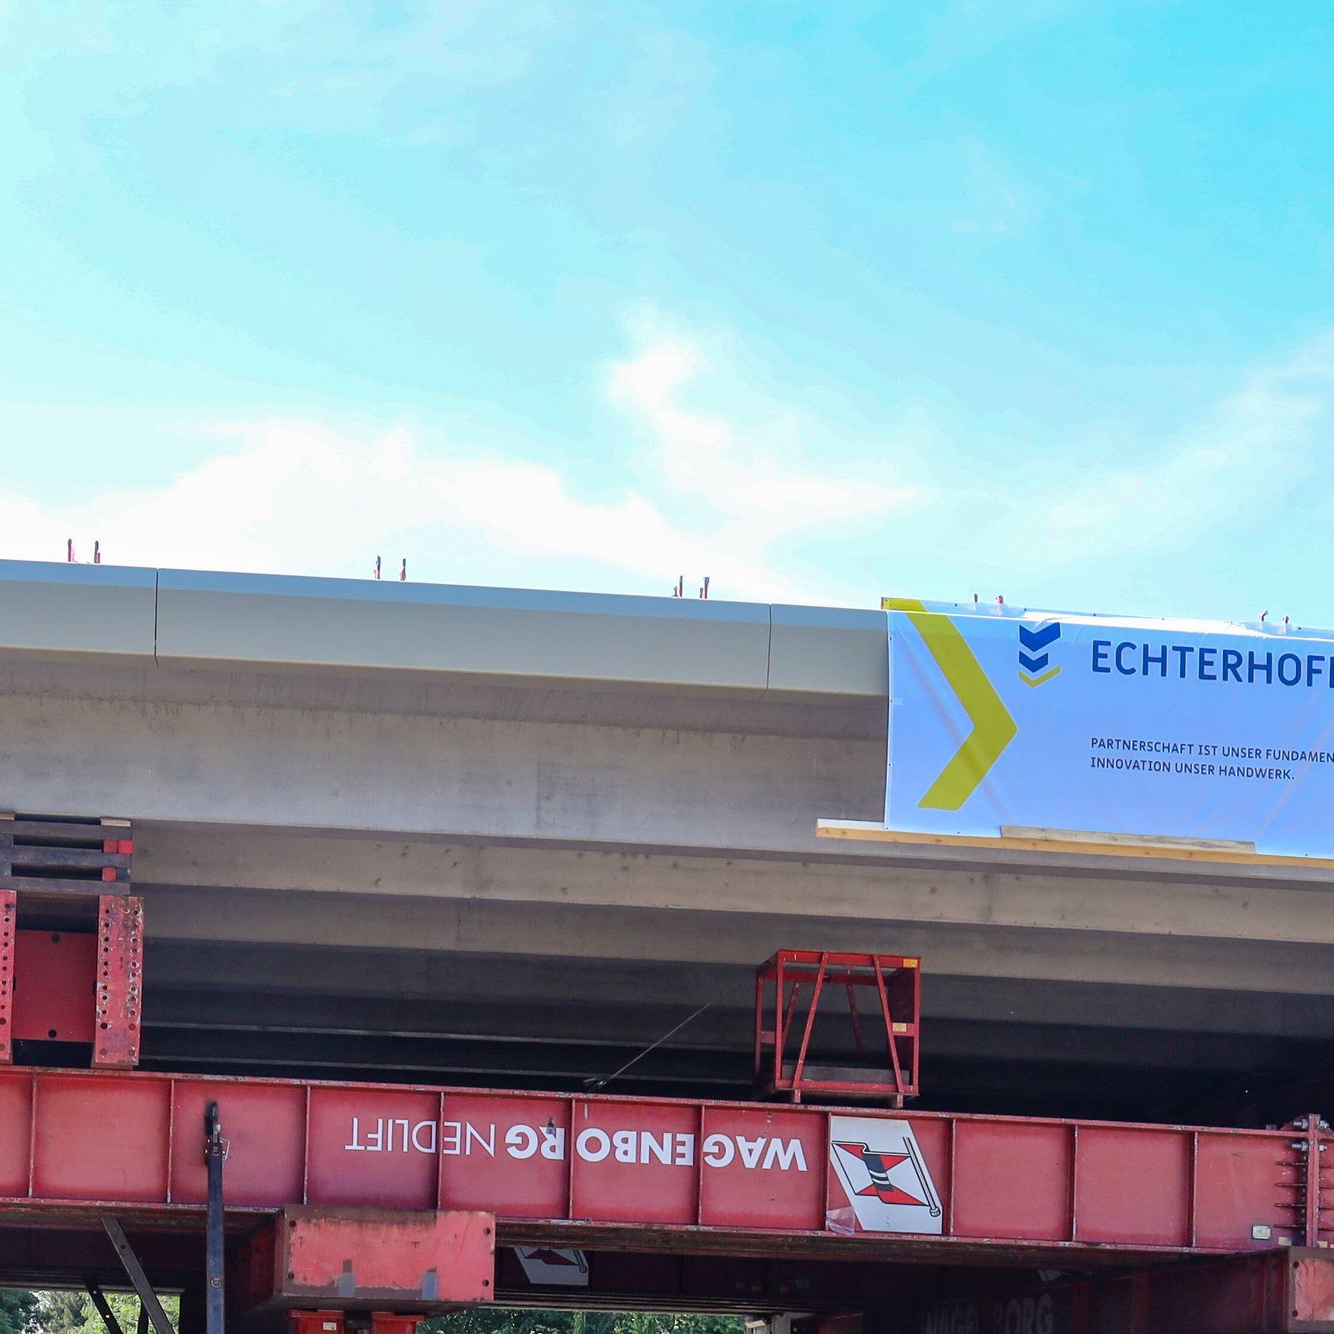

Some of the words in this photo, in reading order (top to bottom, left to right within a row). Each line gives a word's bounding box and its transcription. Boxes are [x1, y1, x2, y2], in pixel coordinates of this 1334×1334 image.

[1090, 737, 1195, 756] PARTNERSCHAFT
[1197, 744, 1218, 757] IST
[1221, 746, 1263, 760] UNSER
[1090, 756, 1171, 773] INNOVATION
[1174, 762, 1216, 776] UNSER
[1218, 765, 1296, 781] HANDWERK.
[344, 1116, 496, 1158] NEDLIFT
[504, 1123, 808, 1172] WAGENBORG
